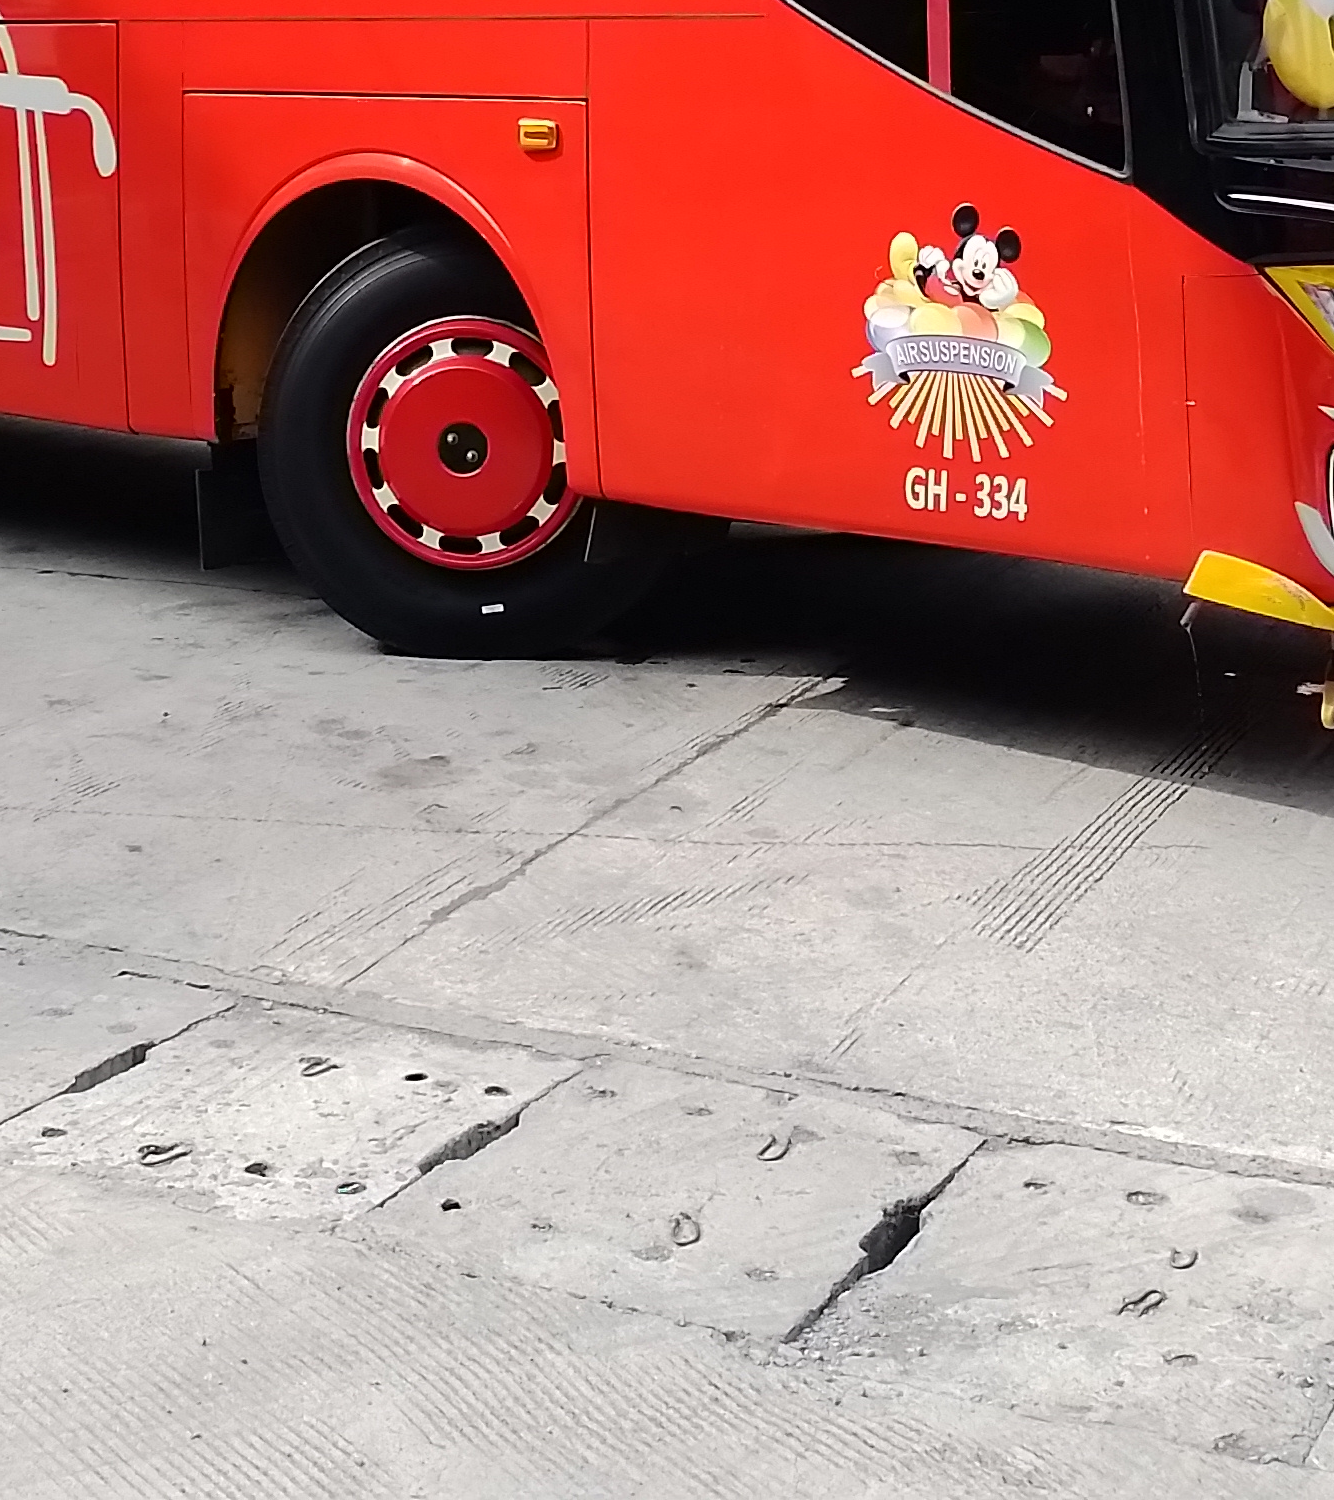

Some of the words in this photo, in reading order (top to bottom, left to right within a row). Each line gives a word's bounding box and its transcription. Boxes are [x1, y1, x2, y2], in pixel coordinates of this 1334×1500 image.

[896, 341, 1017, 374] AIRSUSPENSION
[905, 467, 948, 512] GH
[974, 473, 1028, 521] 334
